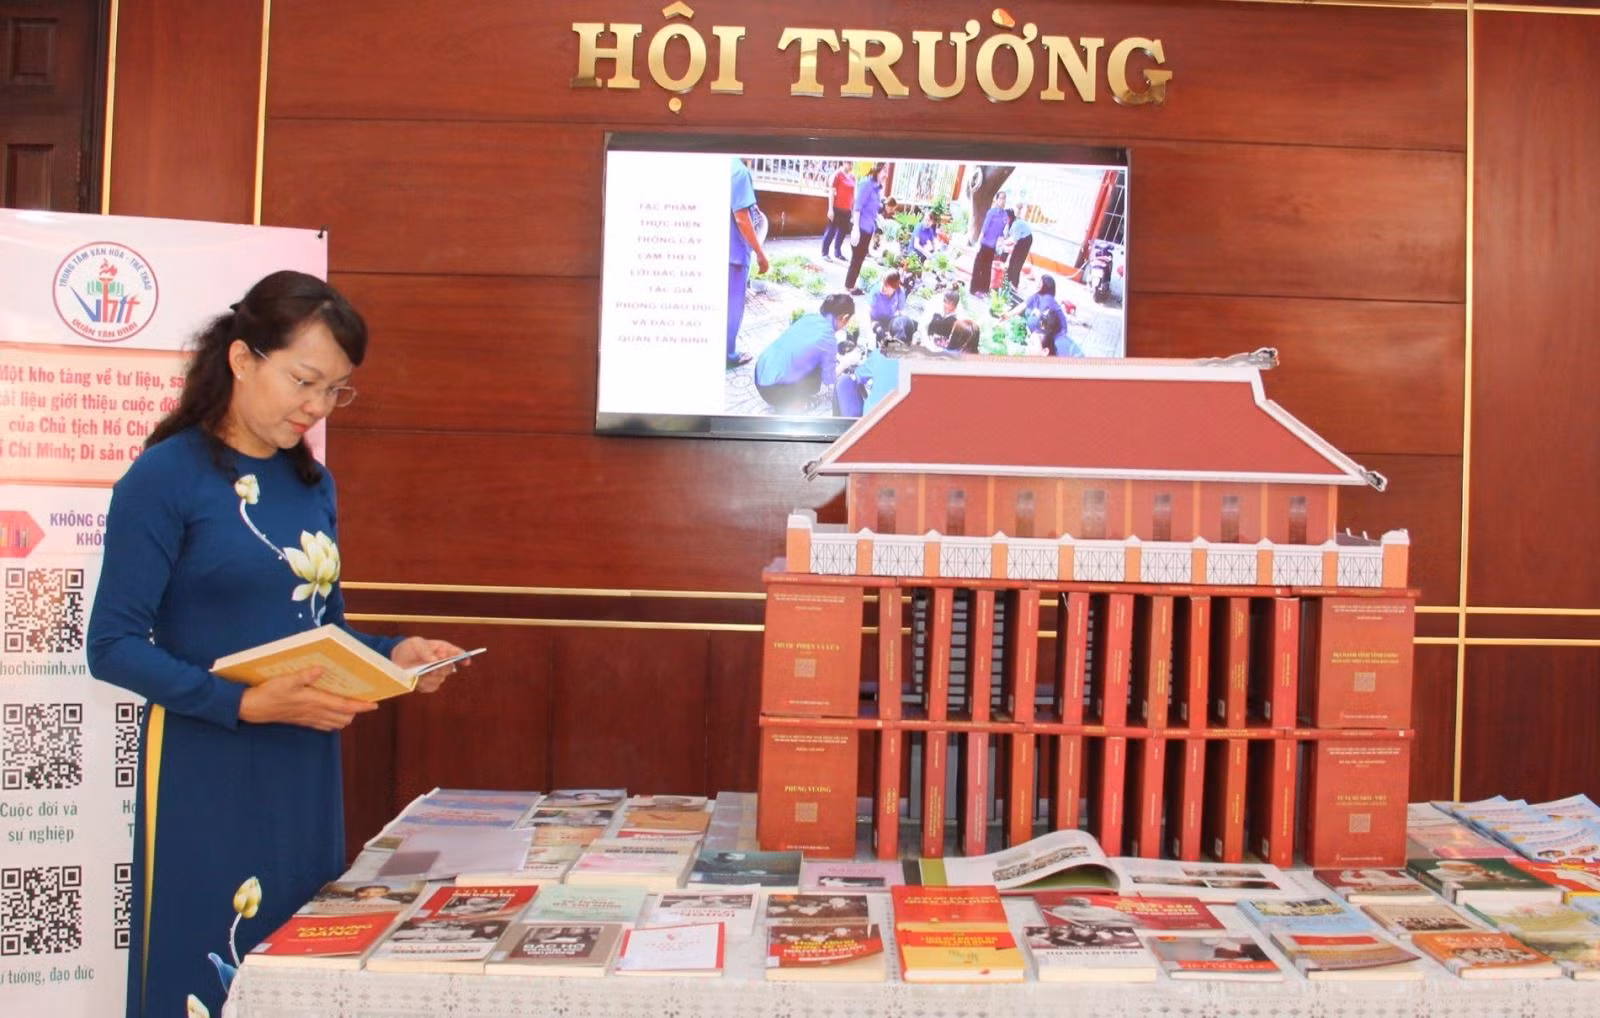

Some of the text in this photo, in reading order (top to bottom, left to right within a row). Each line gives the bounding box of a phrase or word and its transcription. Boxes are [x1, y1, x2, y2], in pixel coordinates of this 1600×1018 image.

[570, 0, 1173, 113] HỘI TRƯỜNG
[29, 366, 55, 383] kho
[60, 367, 91, 388] tàng
[117, 370, 133, 386] tư
[136, 370, 165, 391] liệu,
[20, 391, 46, 412] liệu
[51, 392, 77, 411] giới
[82, 393, 117, 414] thiệu
[122, 395, 155, 415] cuộc
[8, 414, 35, 432] của
[40, 415, 67, 434] Chủ
[71, 418, 98, 438] tịch
[103, 417, 122, 436] Hồ
[127, 420, 149, 436] Chí
[8, 440, 33, 459] Chí
[37, 441, 76, 463] Minh;
[80, 443, 95, 460] Di
[100, 442, 125, 461] sản
[50, 509, 94, 528] KHÔNG
[0, 799, 78, 821] Cuộc đời và
[8, 825, 75, 845] sự nghiệp
[50, 966, 70, 985] đạo
[74, 964, 95, 980] đức
